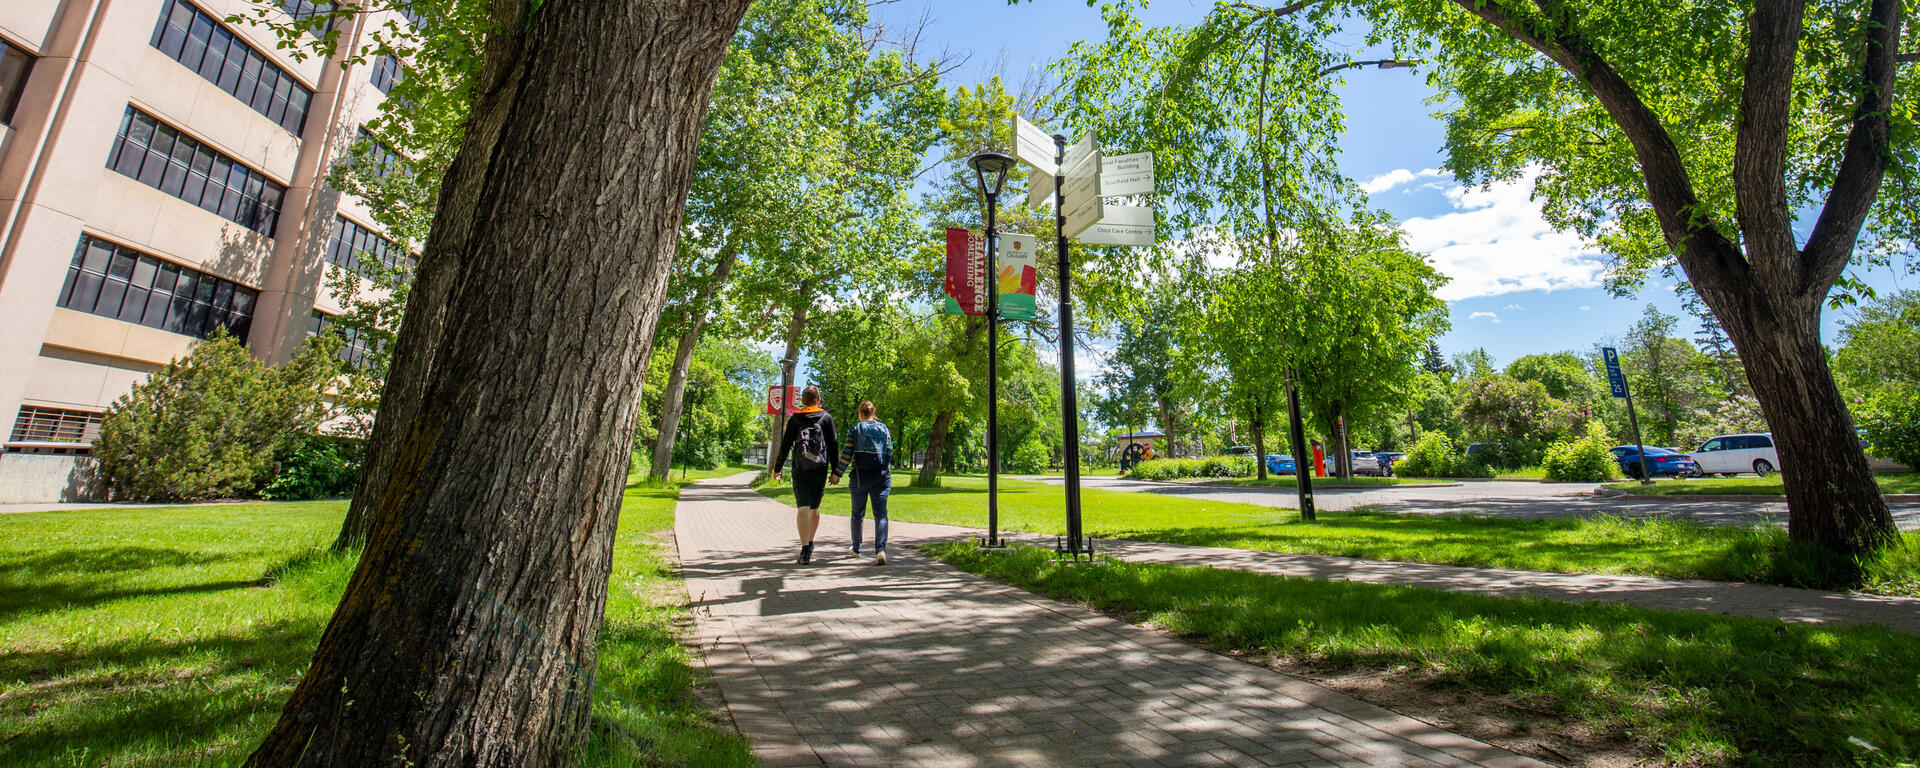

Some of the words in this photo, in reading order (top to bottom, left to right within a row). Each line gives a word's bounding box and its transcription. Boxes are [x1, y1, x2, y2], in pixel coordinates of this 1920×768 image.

[974, 231, 984, 312] CHALLENGE
[1607, 350, 1615, 362] P
[1613, 384, 1622, 393] 25
